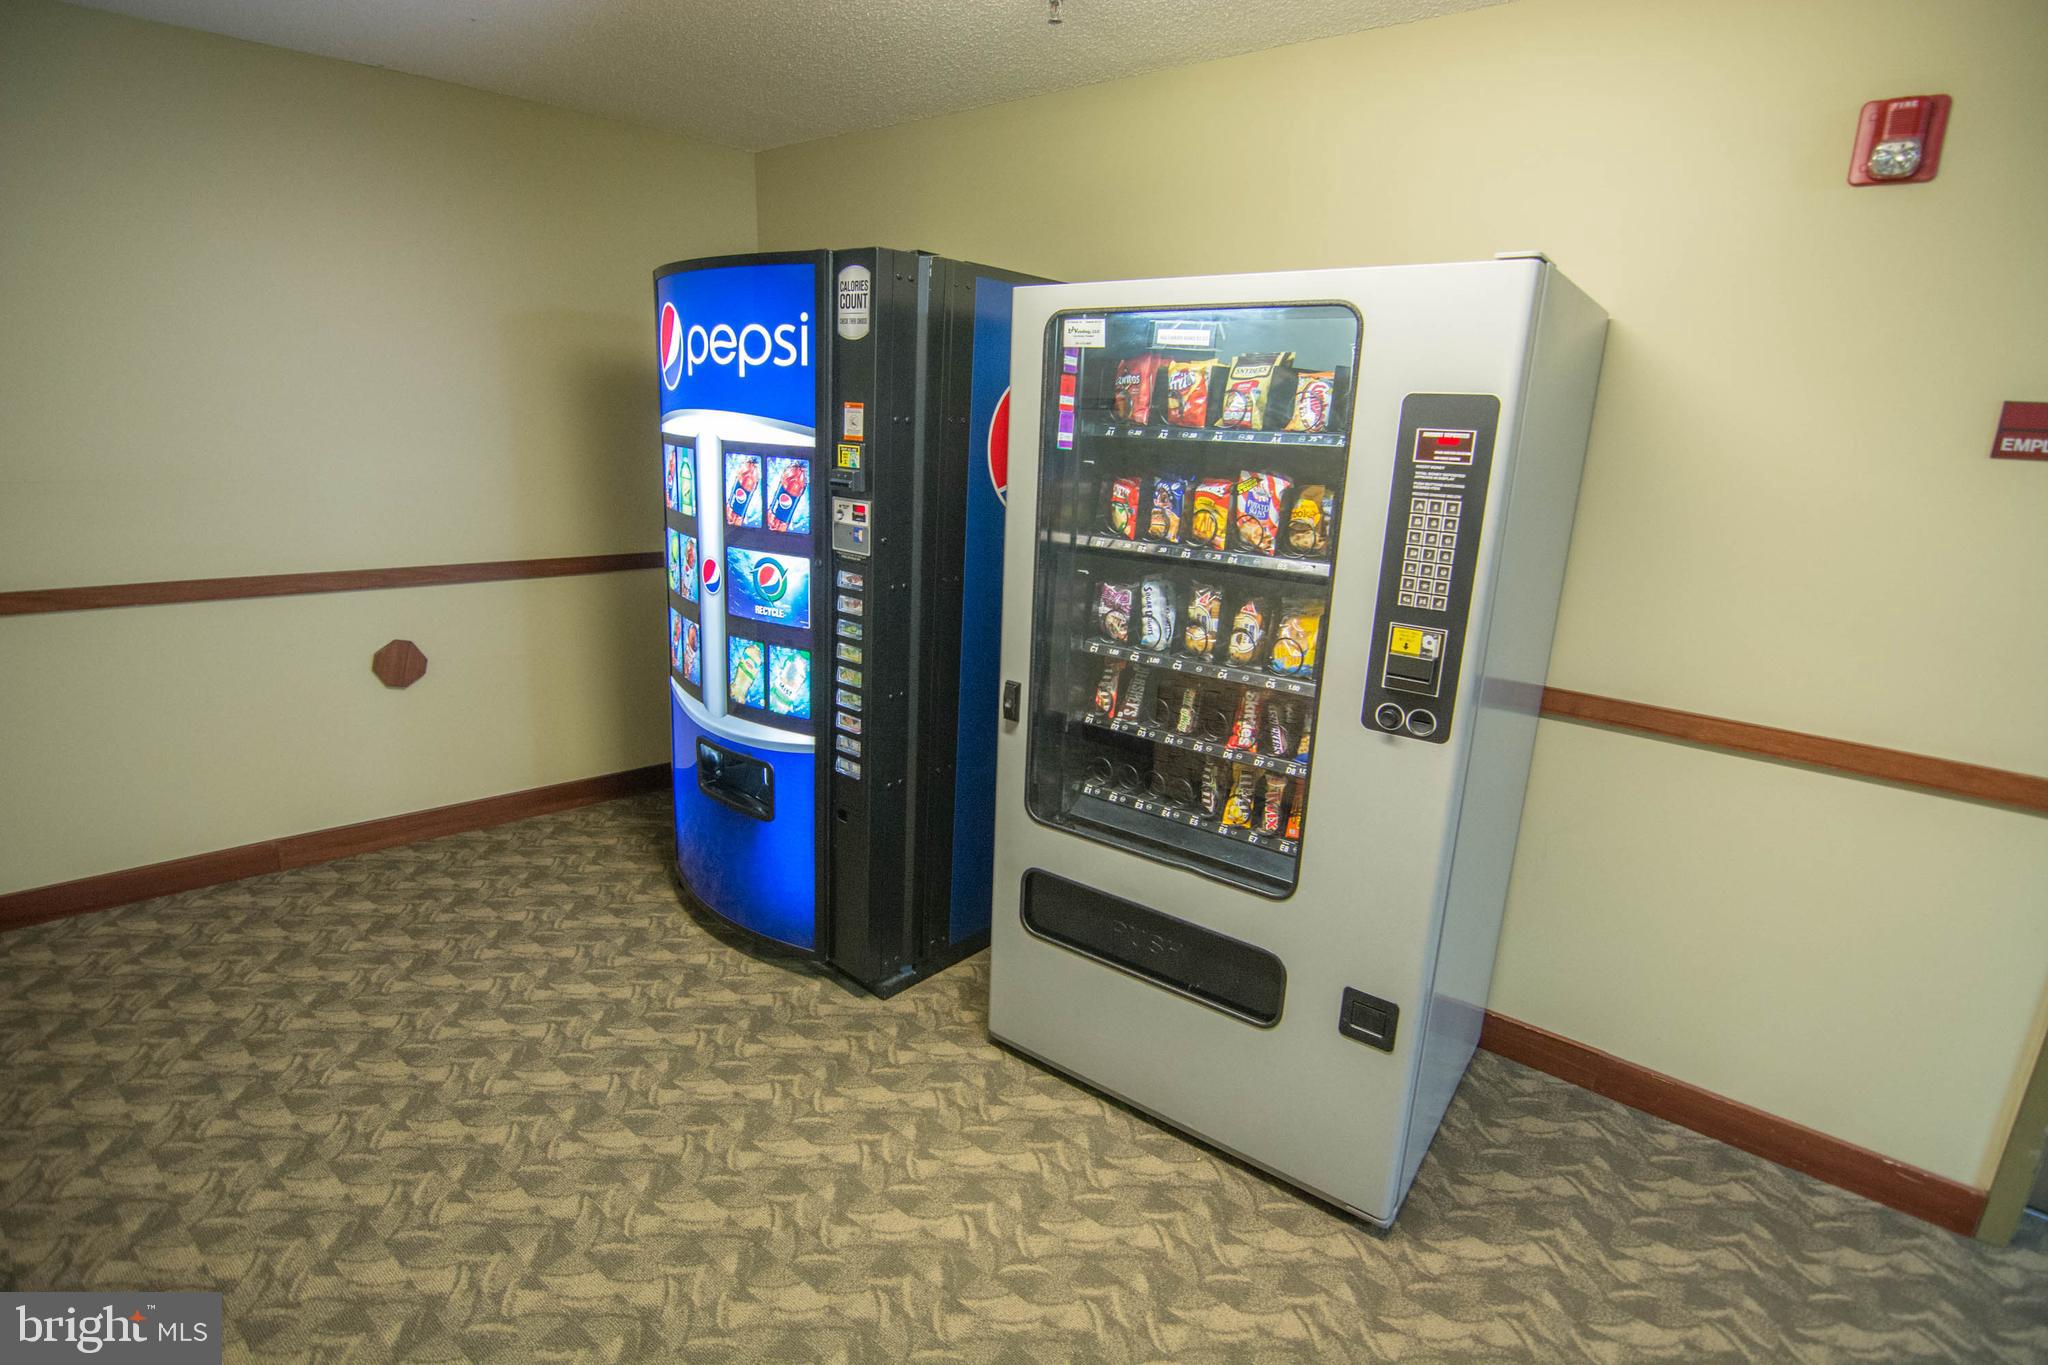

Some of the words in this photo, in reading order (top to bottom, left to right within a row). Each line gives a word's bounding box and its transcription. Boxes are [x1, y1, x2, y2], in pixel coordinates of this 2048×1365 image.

[840, 280, 869, 292] CALORIES
[840, 294, 868, 309] COUNT
[687, 311, 809, 378] pepsi
[755, 605, 784, 618] RECYCLE
